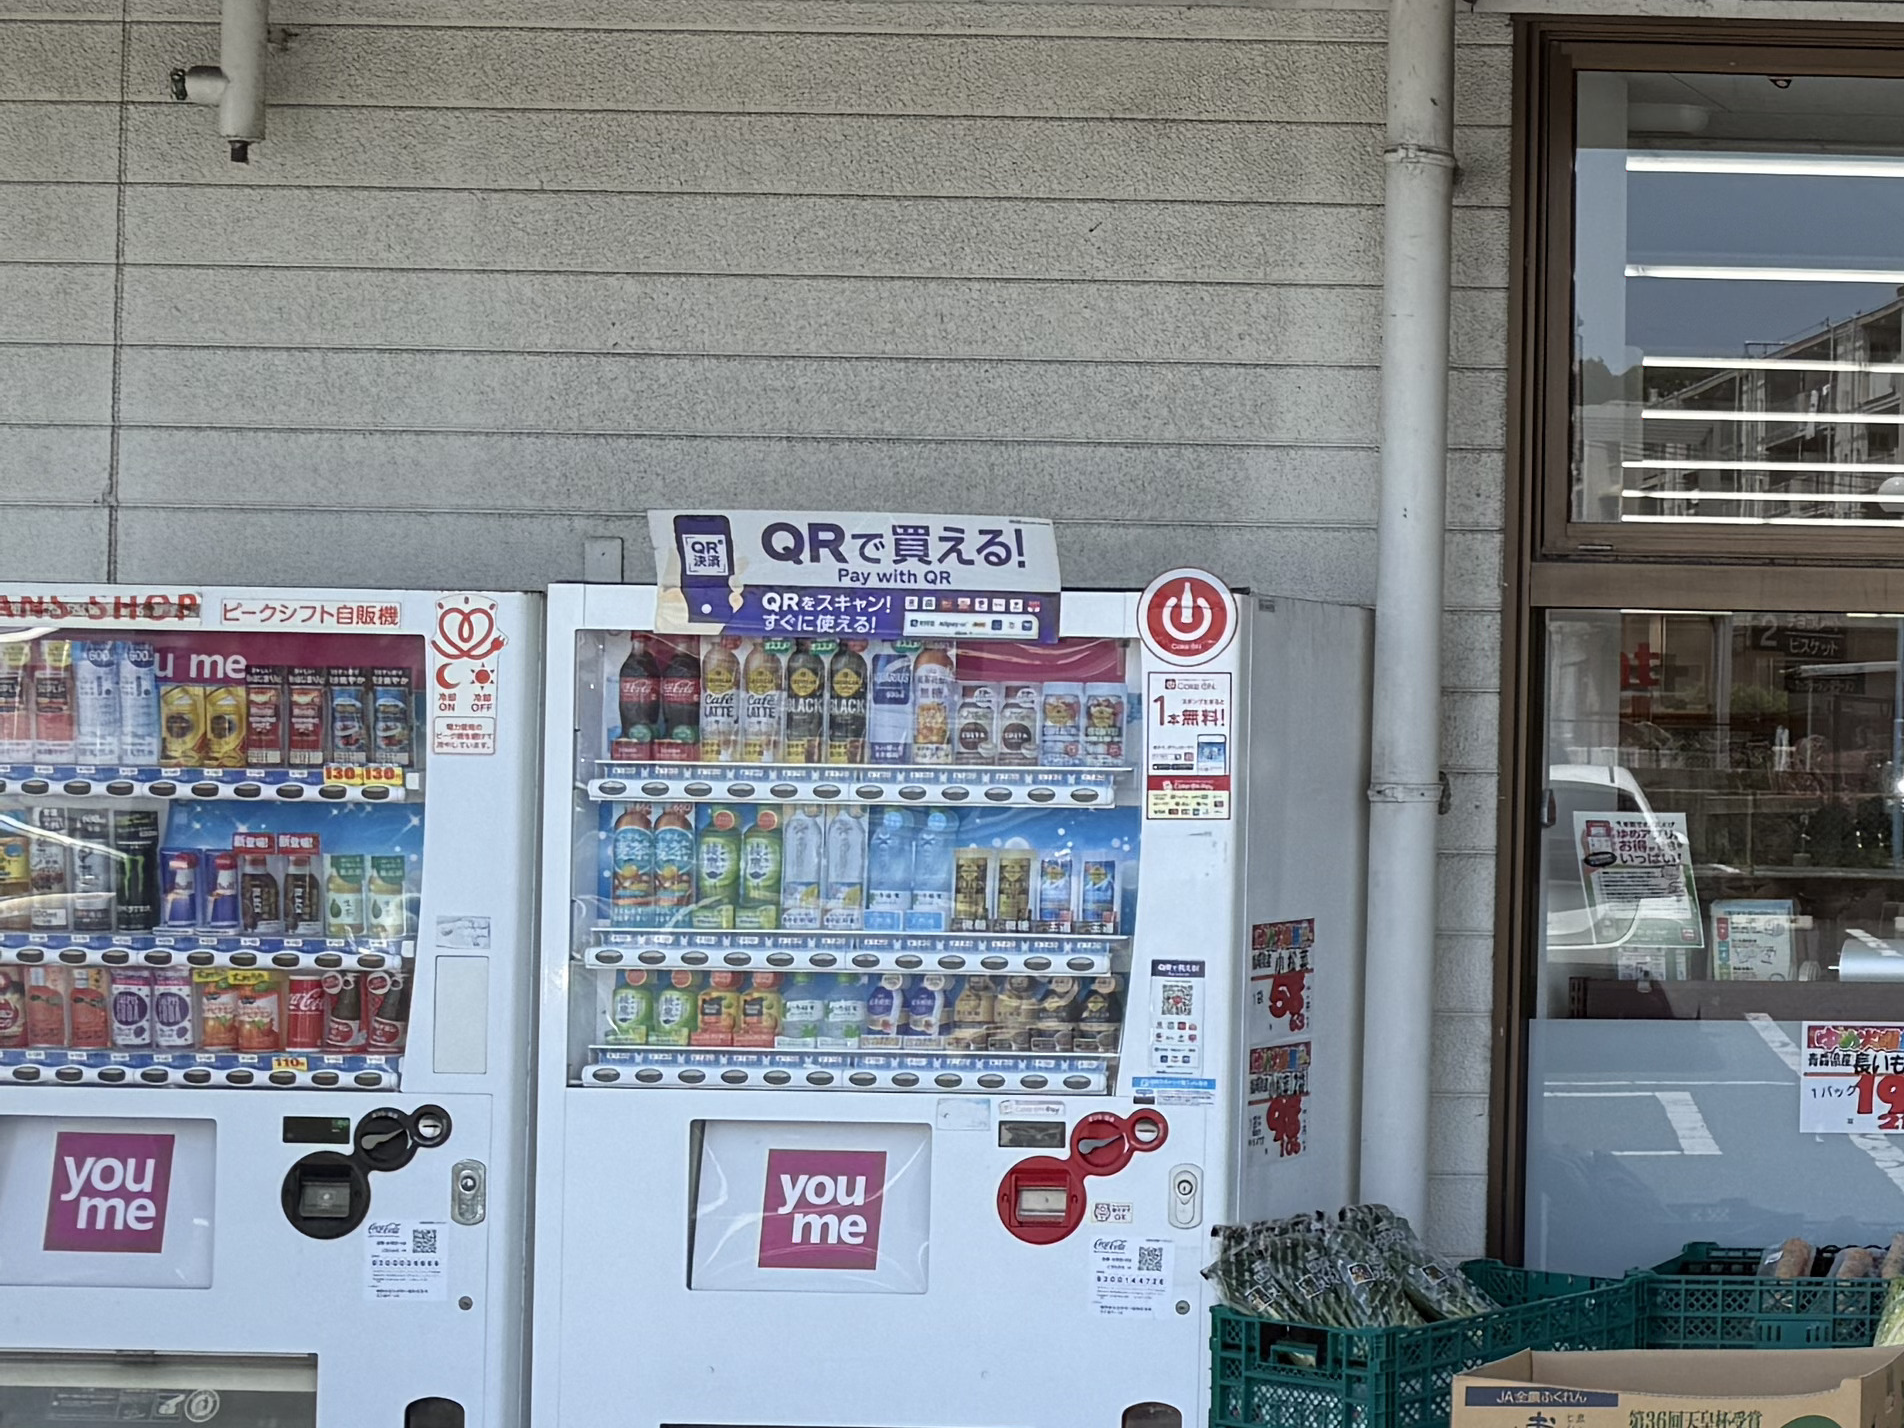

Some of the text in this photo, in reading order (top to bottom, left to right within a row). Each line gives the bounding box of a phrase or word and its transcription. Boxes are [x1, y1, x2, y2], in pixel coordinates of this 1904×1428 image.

[761, 521, 1027, 569] QRで買える!
[838, 568, 952, 586] Pay with QR
[223, 603, 399, 626] ピークシフト自販機
[762, 592, 891, 613] QRをスキャン!
[762, 613, 876, 635] すぐに使える!
[439, 704, 493, 712] ON OFF
[64, 1156, 156, 1200] you
[780, 1173, 866, 1213] you
[76, 1196, 157, 1231] me
[791, 1211, 867, 1245] me
